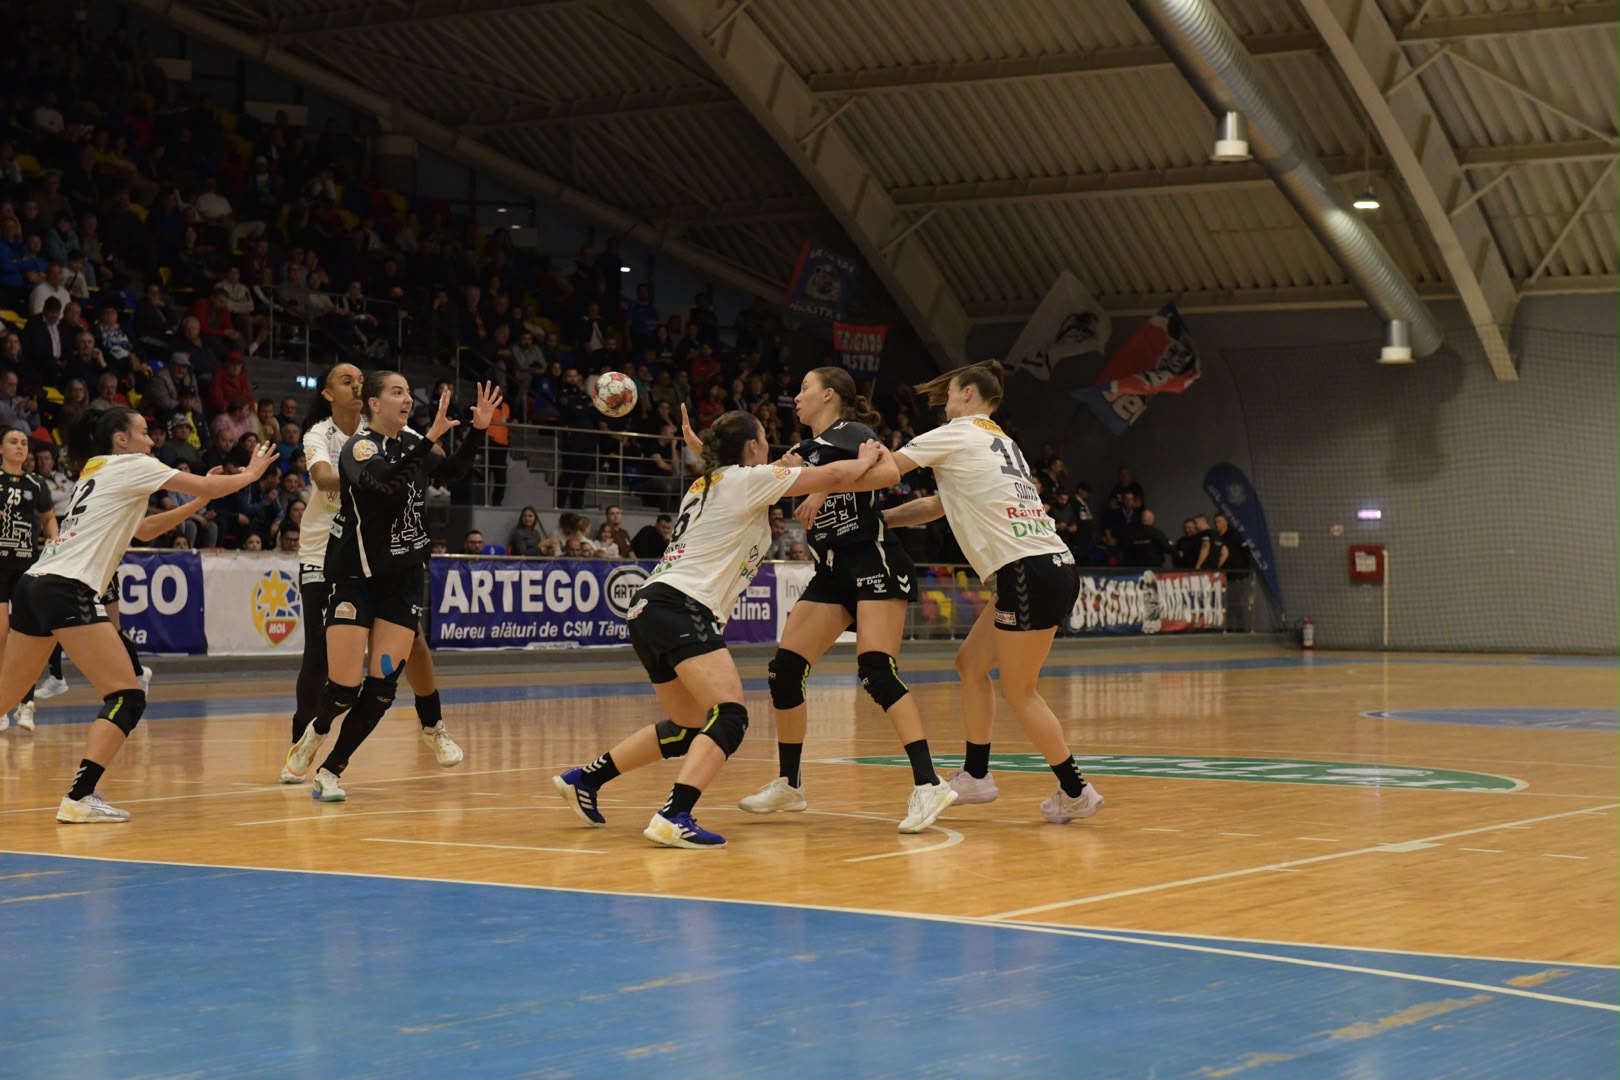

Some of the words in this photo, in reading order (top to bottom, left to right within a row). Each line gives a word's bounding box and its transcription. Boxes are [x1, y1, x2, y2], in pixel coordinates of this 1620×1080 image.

[7, 488, 21, 505] 25
[439, 569, 600, 614] ARTEGO
[269, 622, 287, 635] MOL
[440, 623, 486, 640] Mereu
[491, 621, 537, 639] alături
[539, 621, 558, 638] de
[563, 621, 593, 638] CSM
[598, 620, 631, 639] Târg
